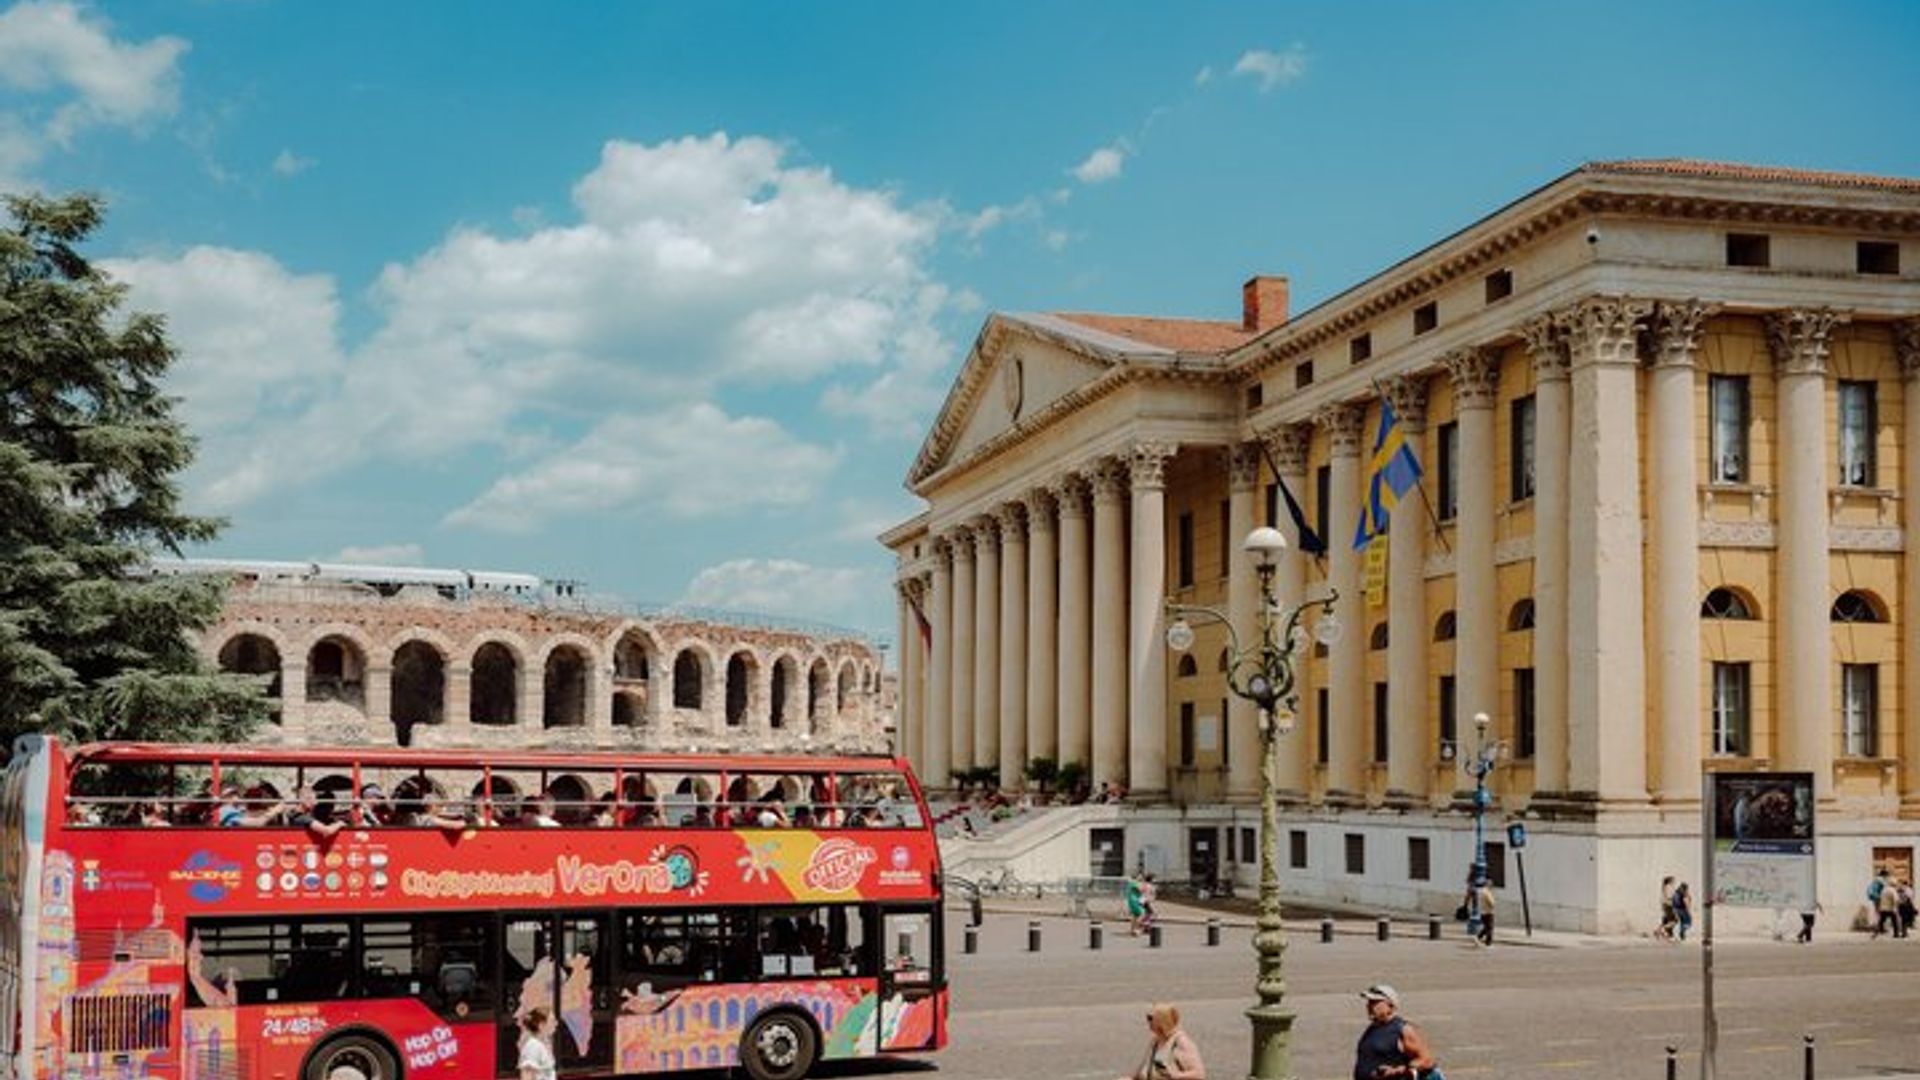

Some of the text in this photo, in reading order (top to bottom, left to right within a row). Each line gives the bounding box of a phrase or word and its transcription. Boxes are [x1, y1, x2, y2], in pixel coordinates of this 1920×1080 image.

[557, 855, 672, 894] Verona
[405, 1027, 452, 1053] Hop On
[410, 1039, 458, 1069] Hop Off
